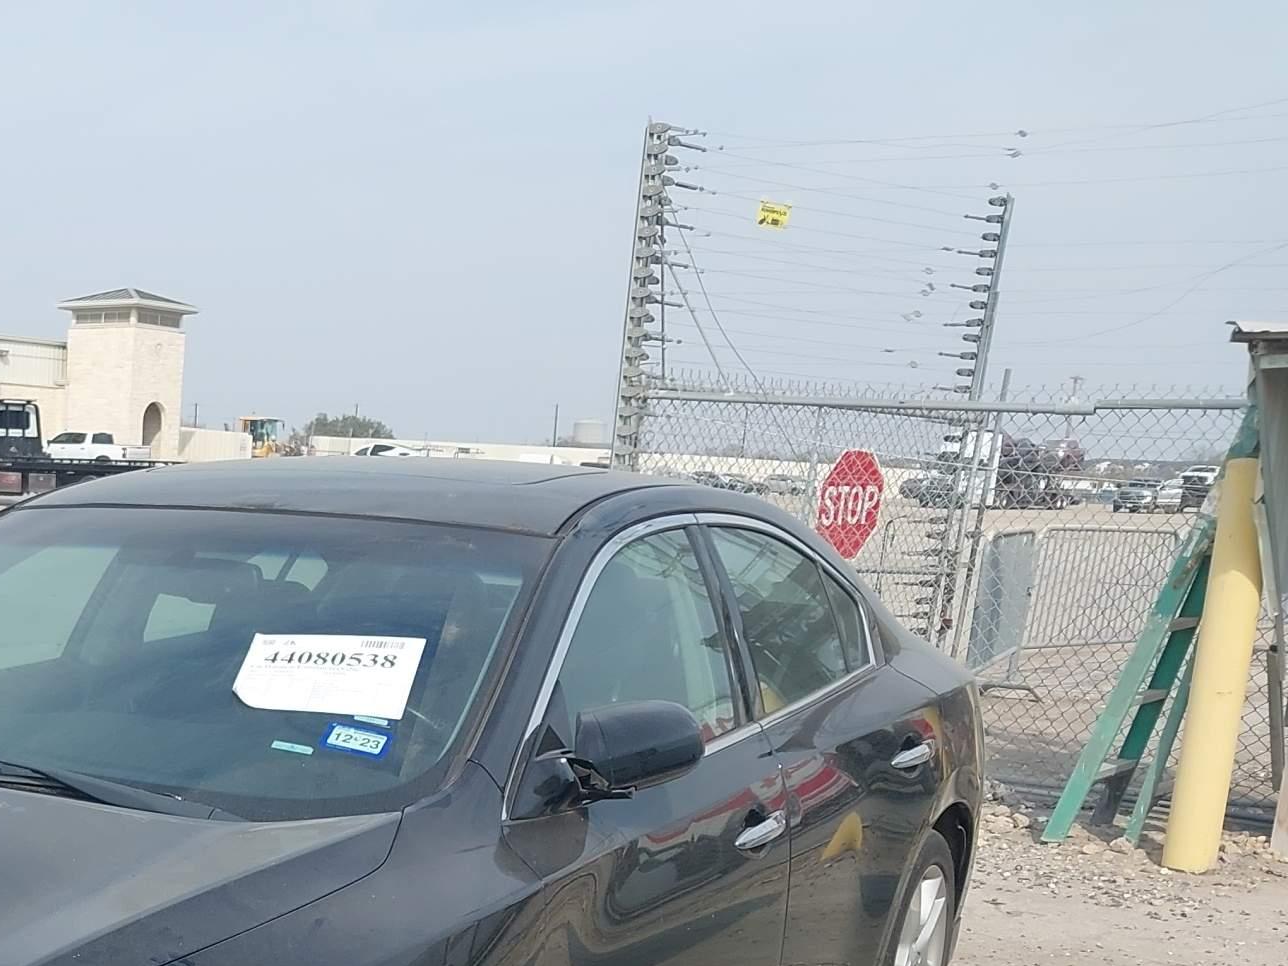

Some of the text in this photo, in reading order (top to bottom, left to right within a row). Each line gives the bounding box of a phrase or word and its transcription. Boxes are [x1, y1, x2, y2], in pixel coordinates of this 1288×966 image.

[821, 485, 880, 527] STOP
[264, 650, 398, 669] 44080538
[335, 732, 354, 744] 12
[359, 737, 381, 750] 23
